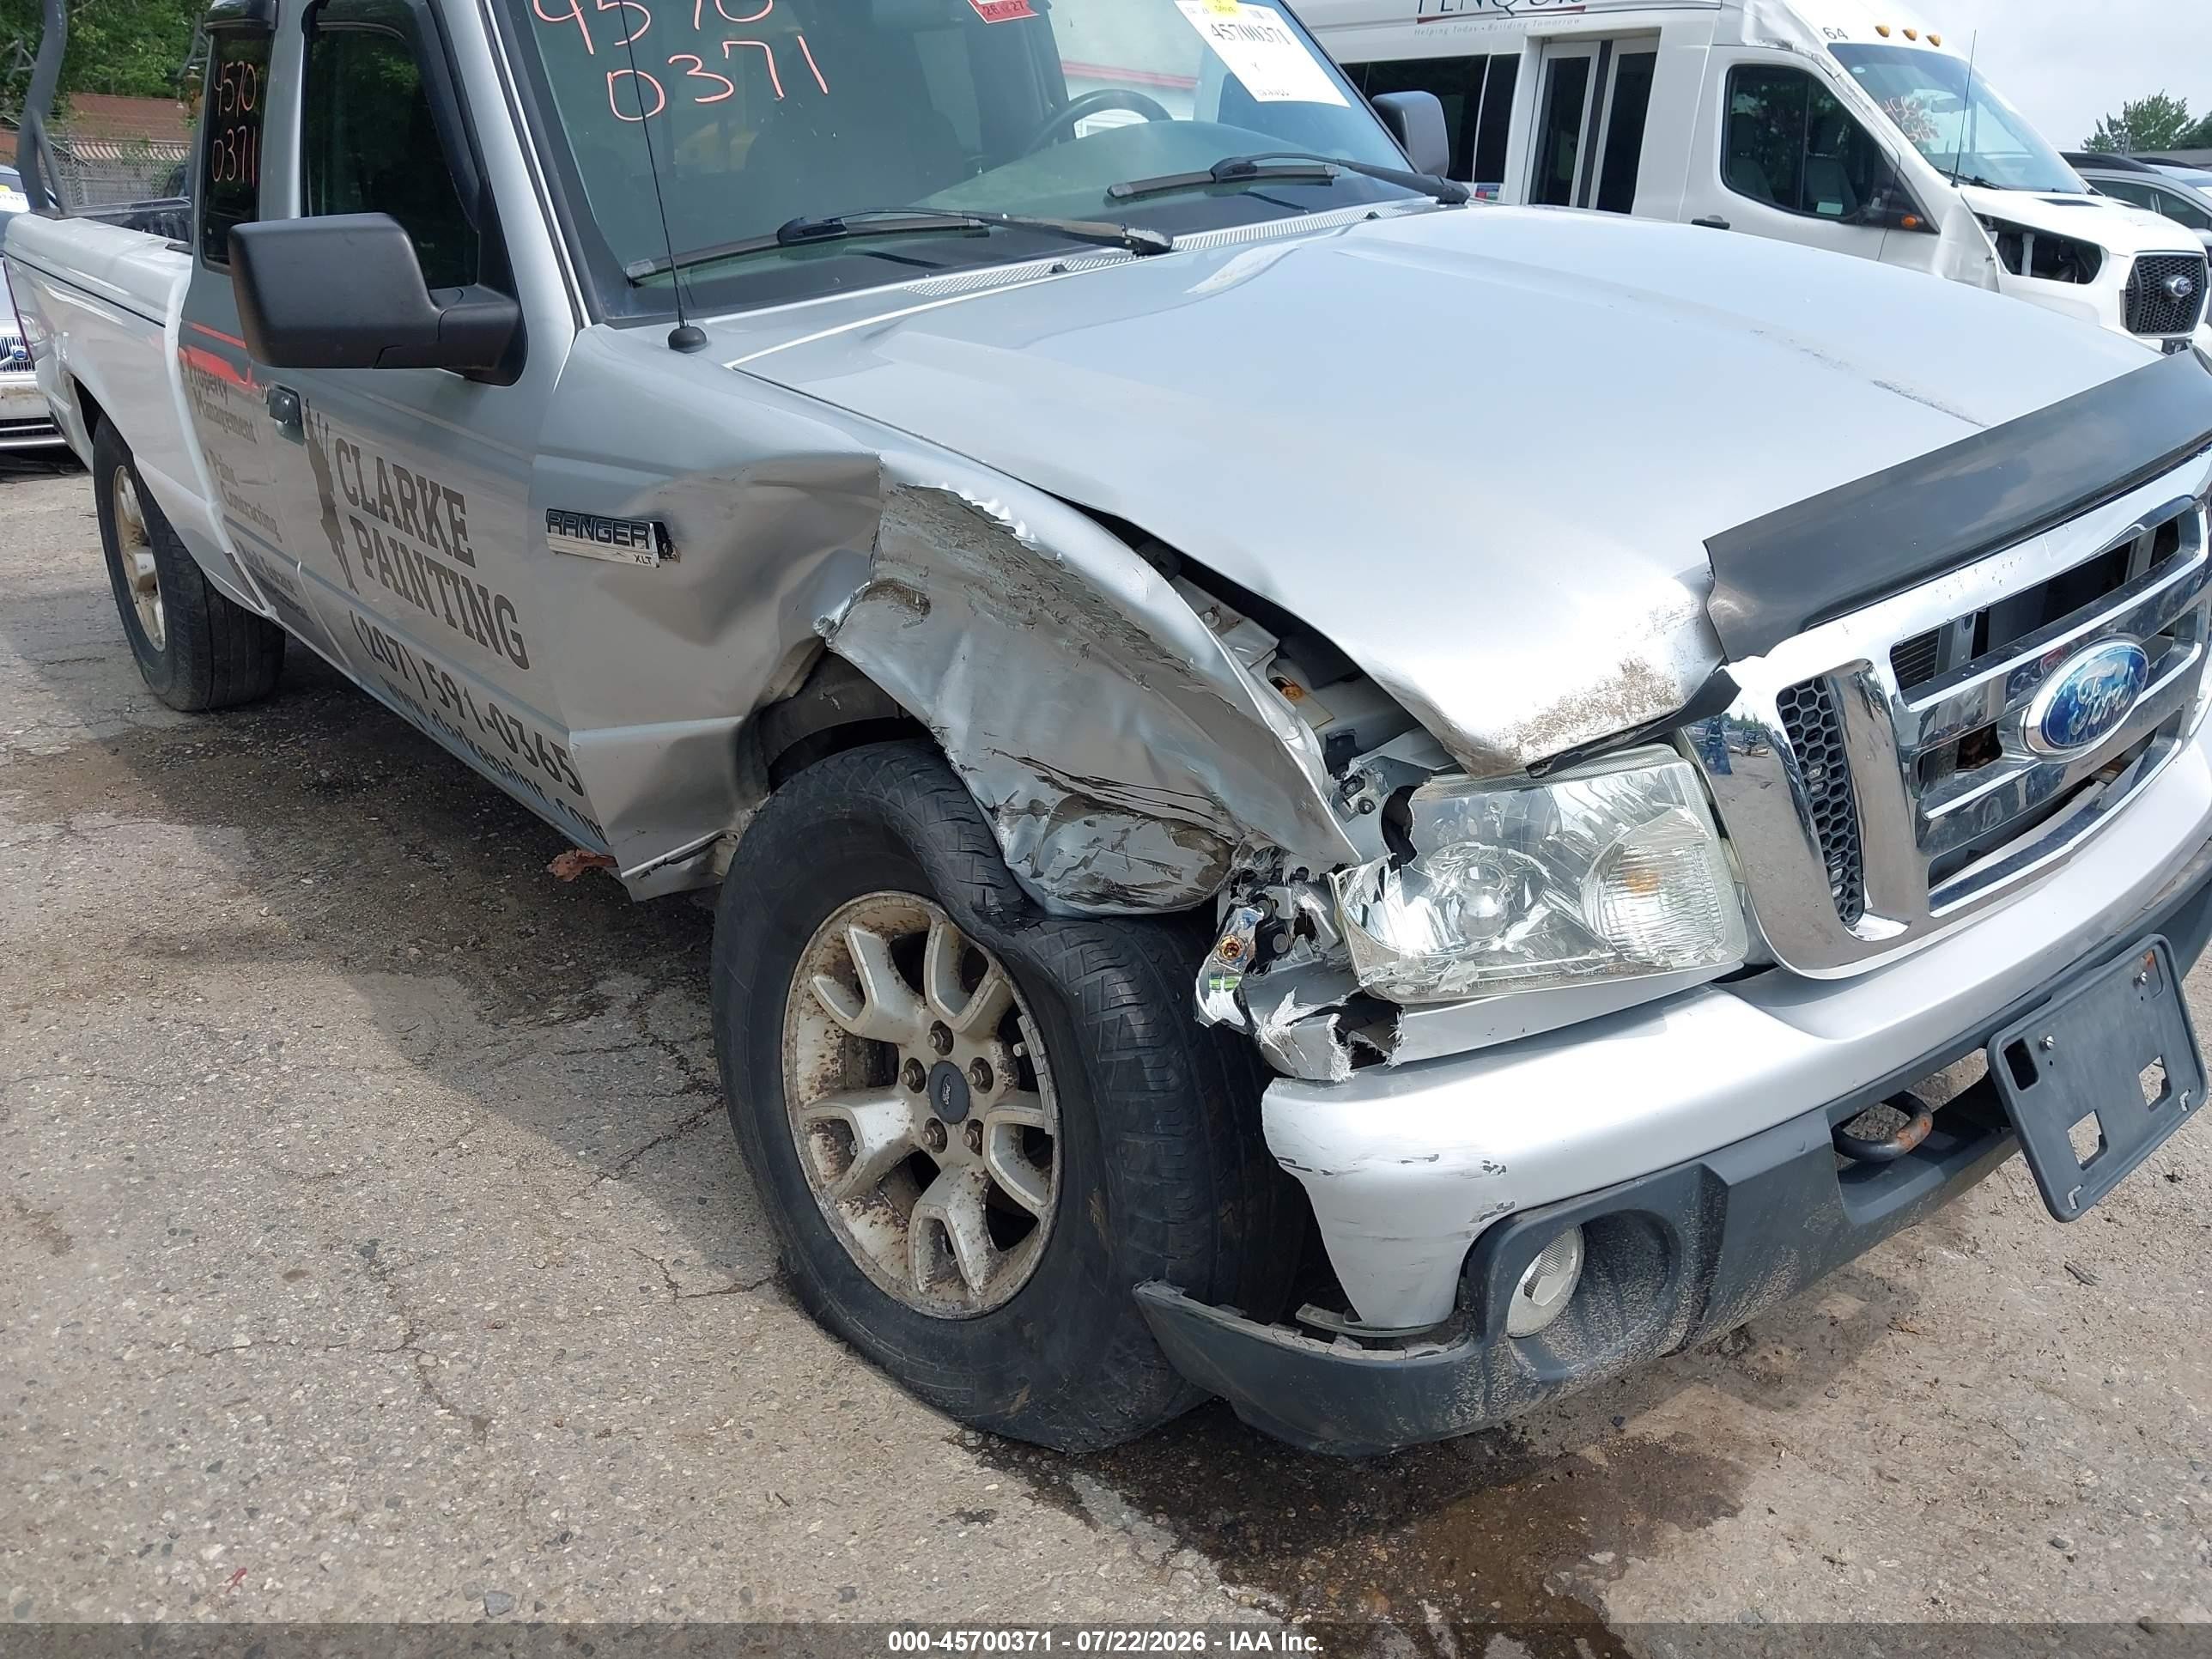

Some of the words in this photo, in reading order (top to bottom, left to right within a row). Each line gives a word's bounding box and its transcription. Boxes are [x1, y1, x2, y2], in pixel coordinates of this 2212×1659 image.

[1211, 23, 1291, 45] 45700371
[1487, 21, 1528, 31] Building
[1533, 18, 1580, 27] Tomorrow
[1823, 27, 1849, 40] 64
[214, 60, 257, 117] 4570
[607, 34, 829, 121] 0371
[212, 125, 256, 187] 0371
[335, 437, 477, 568] CLARKE
[547, 511, 650, 550] RANGER
[634, 554, 653, 565] XLT
[349, 514, 530, 670] PAINTING
[349, 610, 428, 700] (207)
[422, 658, 585, 797] 591-0365
[2068, 664, 2141, 736] Ford
